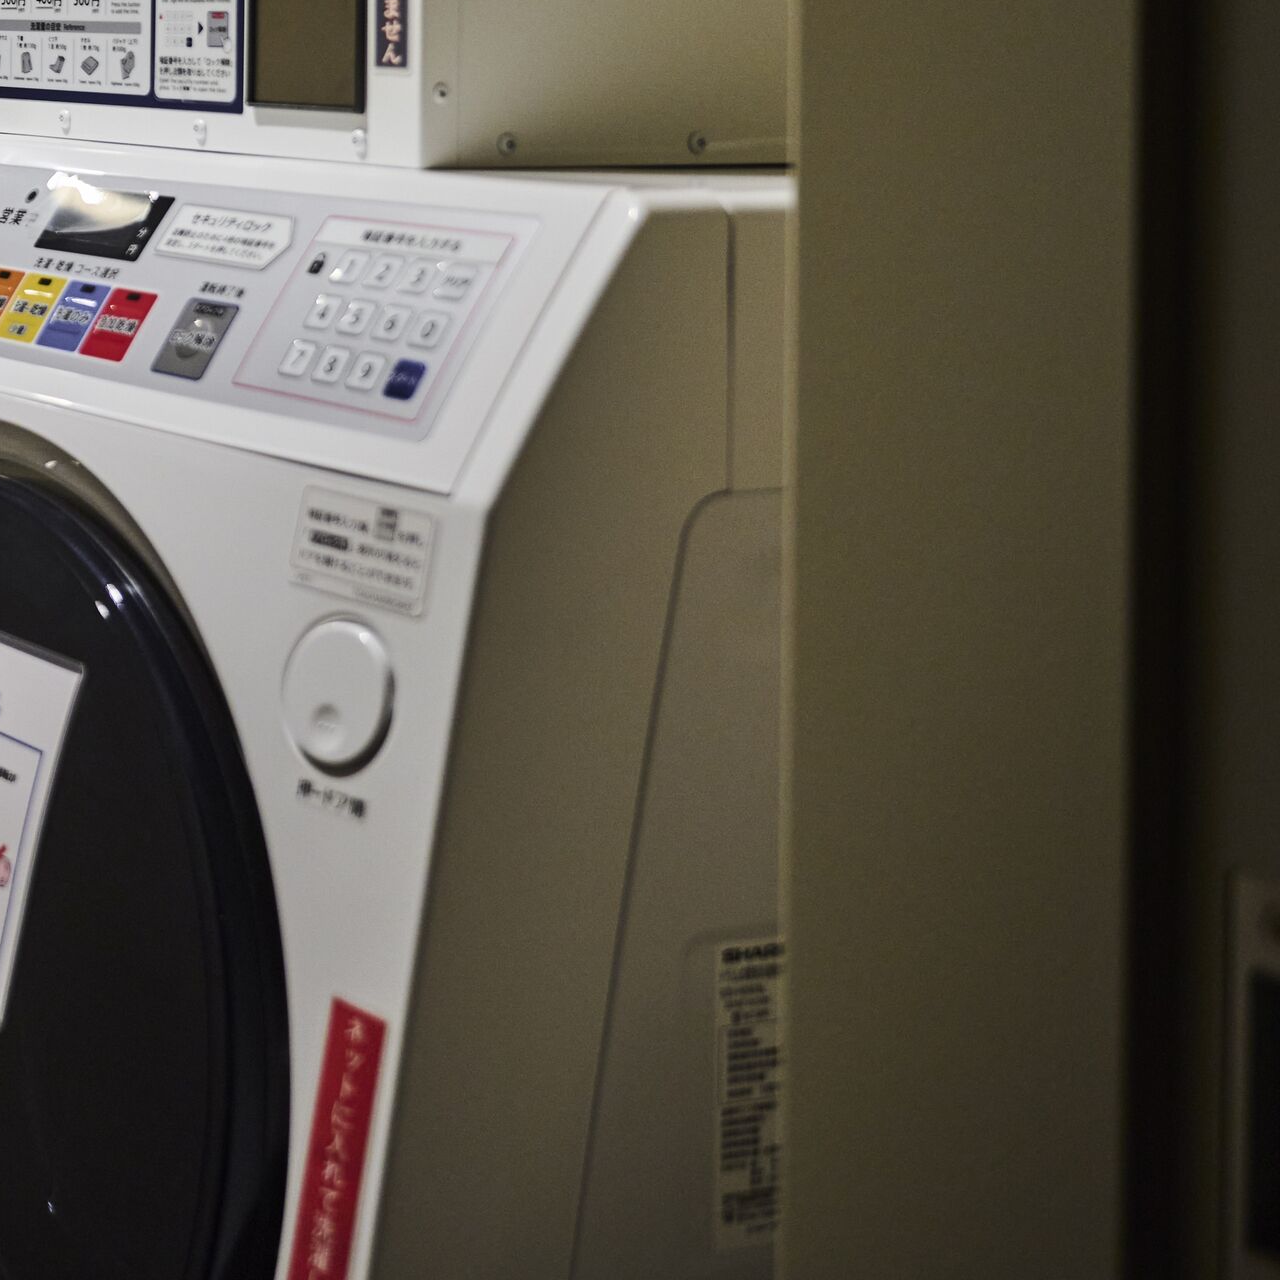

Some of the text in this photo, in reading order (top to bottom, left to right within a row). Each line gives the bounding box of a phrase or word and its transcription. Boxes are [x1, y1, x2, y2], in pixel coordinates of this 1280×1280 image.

[191, 212, 273, 234] セキュリティロック
[374, 263, 390, 281] 2
[411, 267, 426, 286] 3
